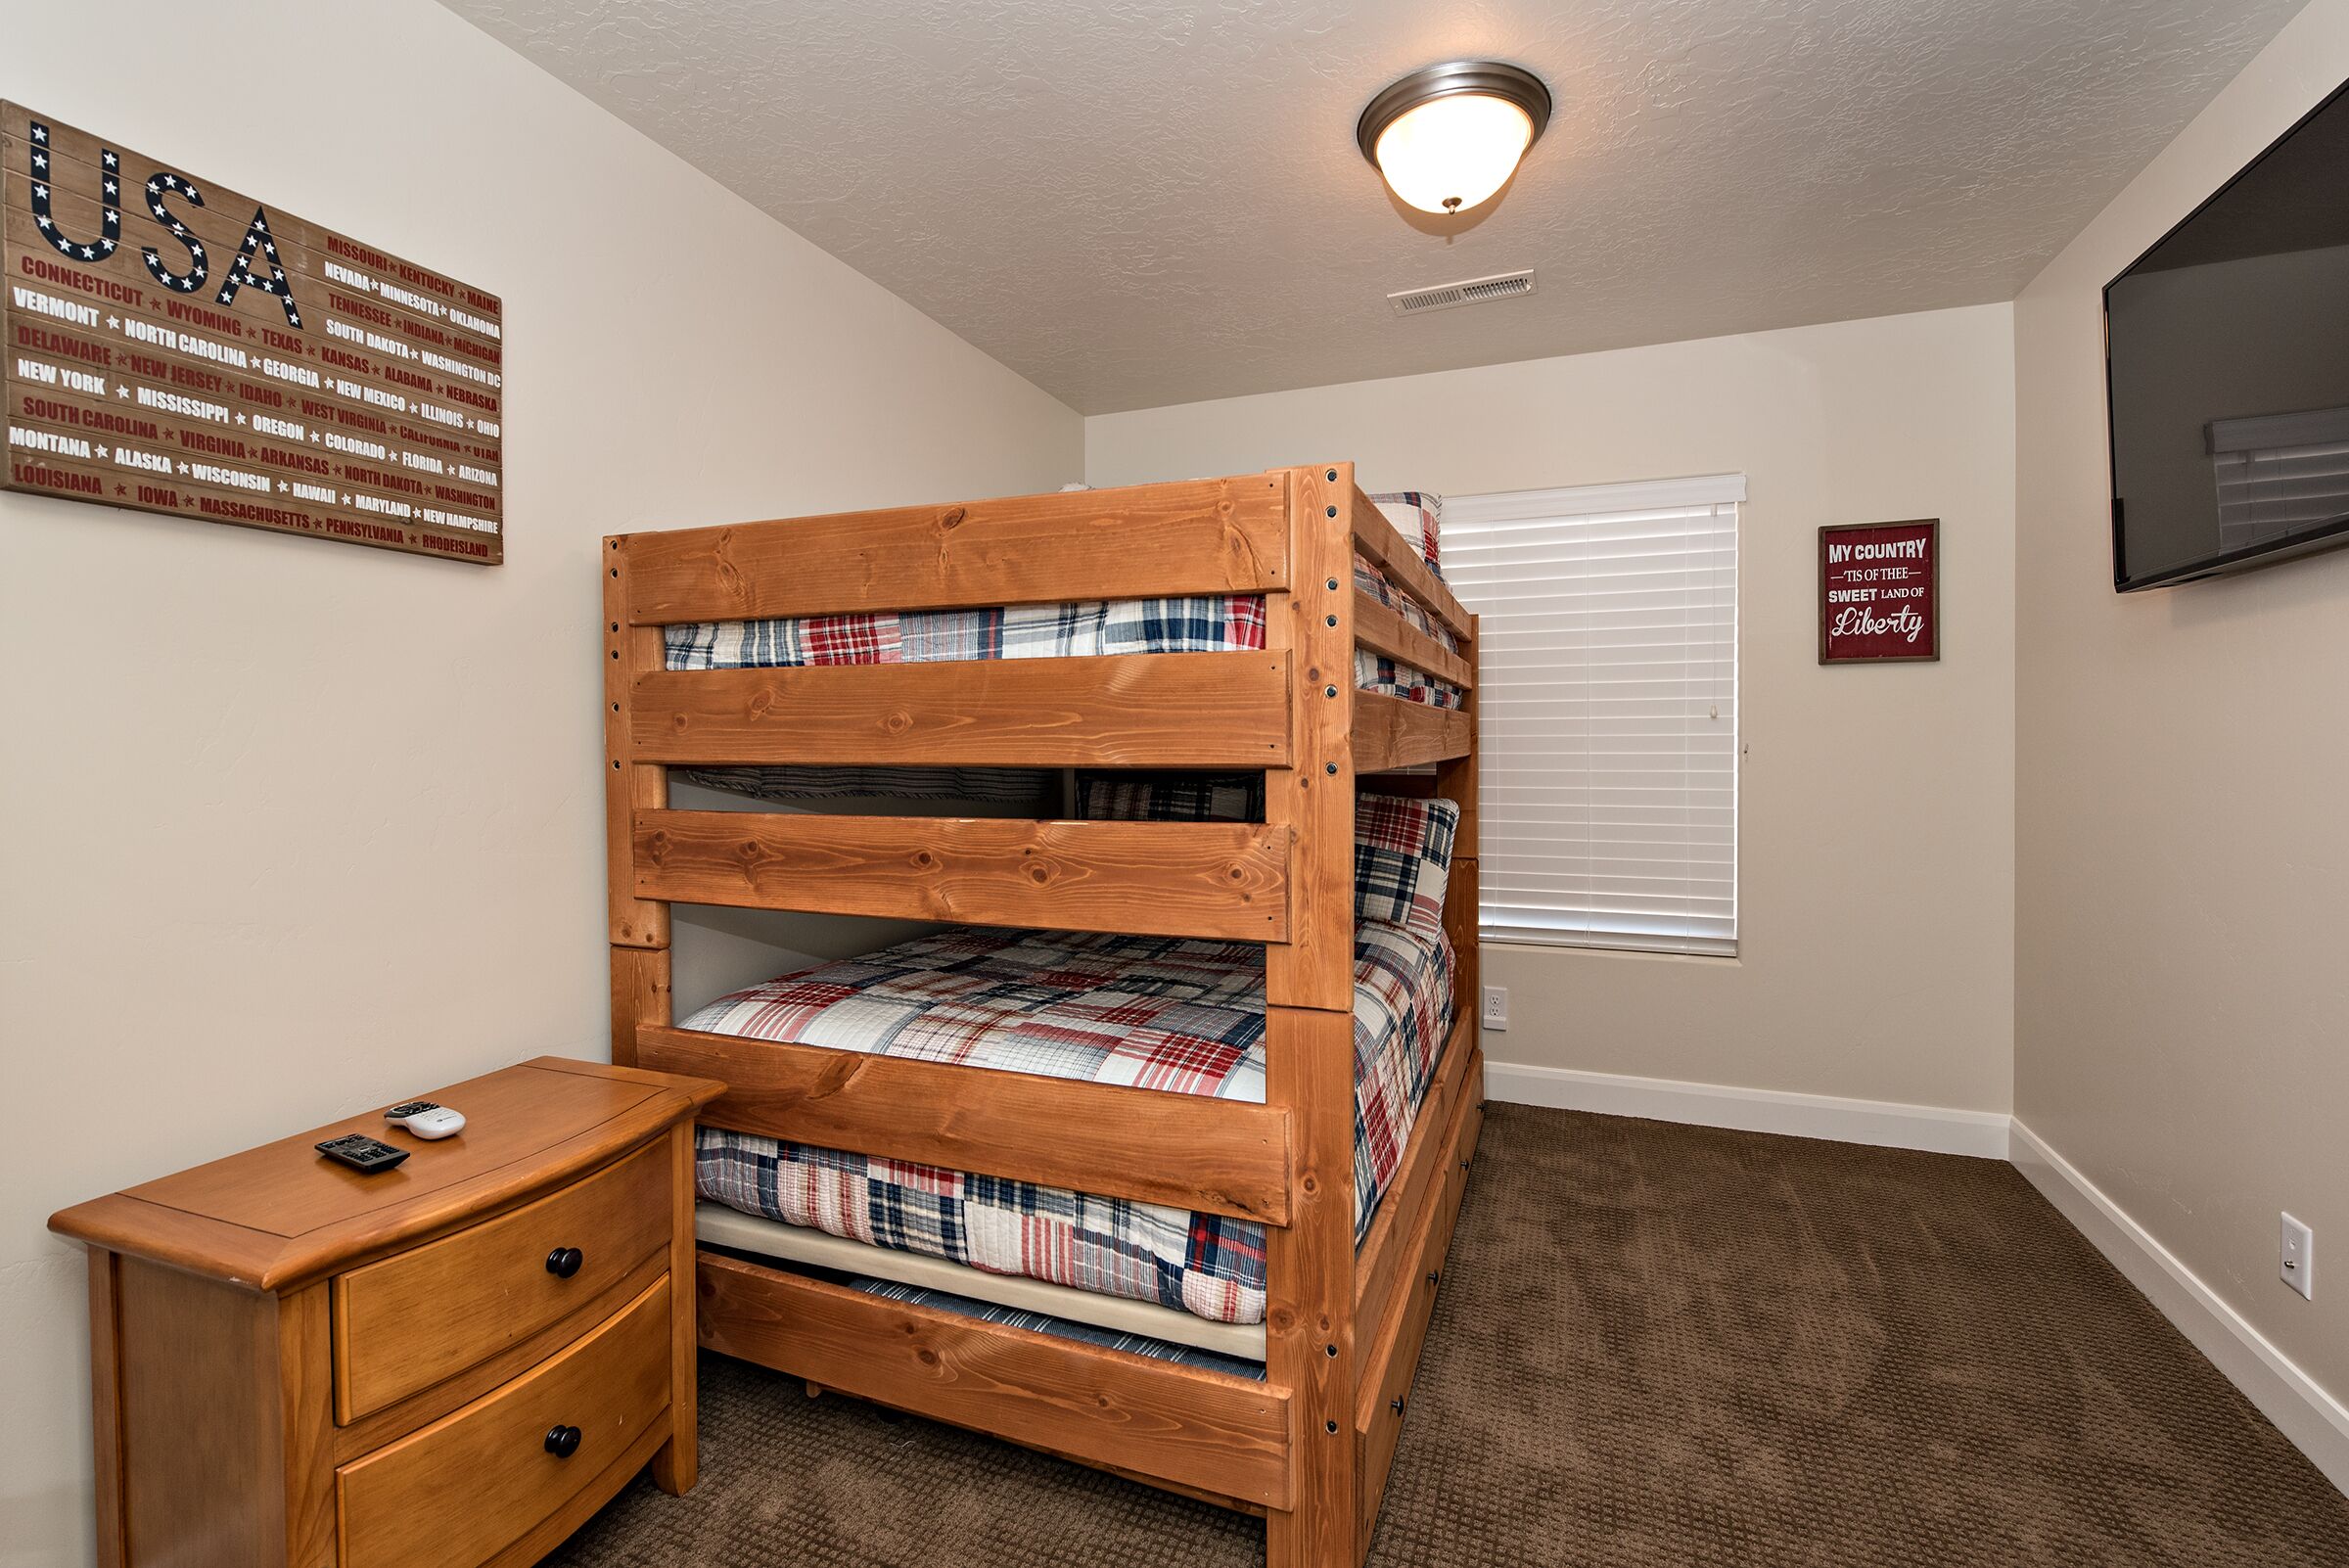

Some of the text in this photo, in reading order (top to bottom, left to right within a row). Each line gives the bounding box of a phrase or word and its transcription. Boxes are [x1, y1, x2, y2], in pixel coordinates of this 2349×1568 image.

[30, 120, 303, 331] USA
[324, 260, 501, 340] NEVADA MINNESOTA OKLAHOMA
[327, 235, 499, 315] MISSOURI KENTUCKY MAINE
[13, 287, 500, 438] VERMONT NORTH CAROLINA GEORGIA NEW MEXICO ILLINOIS OHIO
[22, 255, 497, 412] CONNECTICUT WYOMING TEXAS KANSAS ALABAMA NEBRASKA
[326, 319, 501, 389] SOUTH DAKOTA WASHINGTON DC
[328, 293, 501, 365] TENNESSEE INDIANA MICHIGAN
[18, 326, 499, 462] DELAWARE NEW JERSEY IDAHO WEST VIRGINIA CALIFORNIA UTAH
[18, 358, 497, 486] NEW YORK MISSISSIPPI OREGON COLORADO FLORIDA ARIZONA
[9, 426, 498, 534] MONTANA ALASKA WISCONSIN HAWAII MARYLAND NEW HAMPSHIRE
[23, 396, 495, 510] SOUTH CAROLINA VIRGINIA ARKANSAS NORTH DAKOTA WASHINGTON
[15, 464, 103, 494] LOUISIANA
[137, 484, 178, 508] IOWA
[200, 497, 310, 529] MASSACHUSETTS
[326, 518, 403, 544] PENNSYLVANIA
[1828, 538, 1926, 564] MY COUNTRY
[1843, 567, 1909, 582] 'TIS OF THEE
[1828, 587, 1924, 603] SWEET LAND OF
[1831, 605, 1924, 643] Liberty
